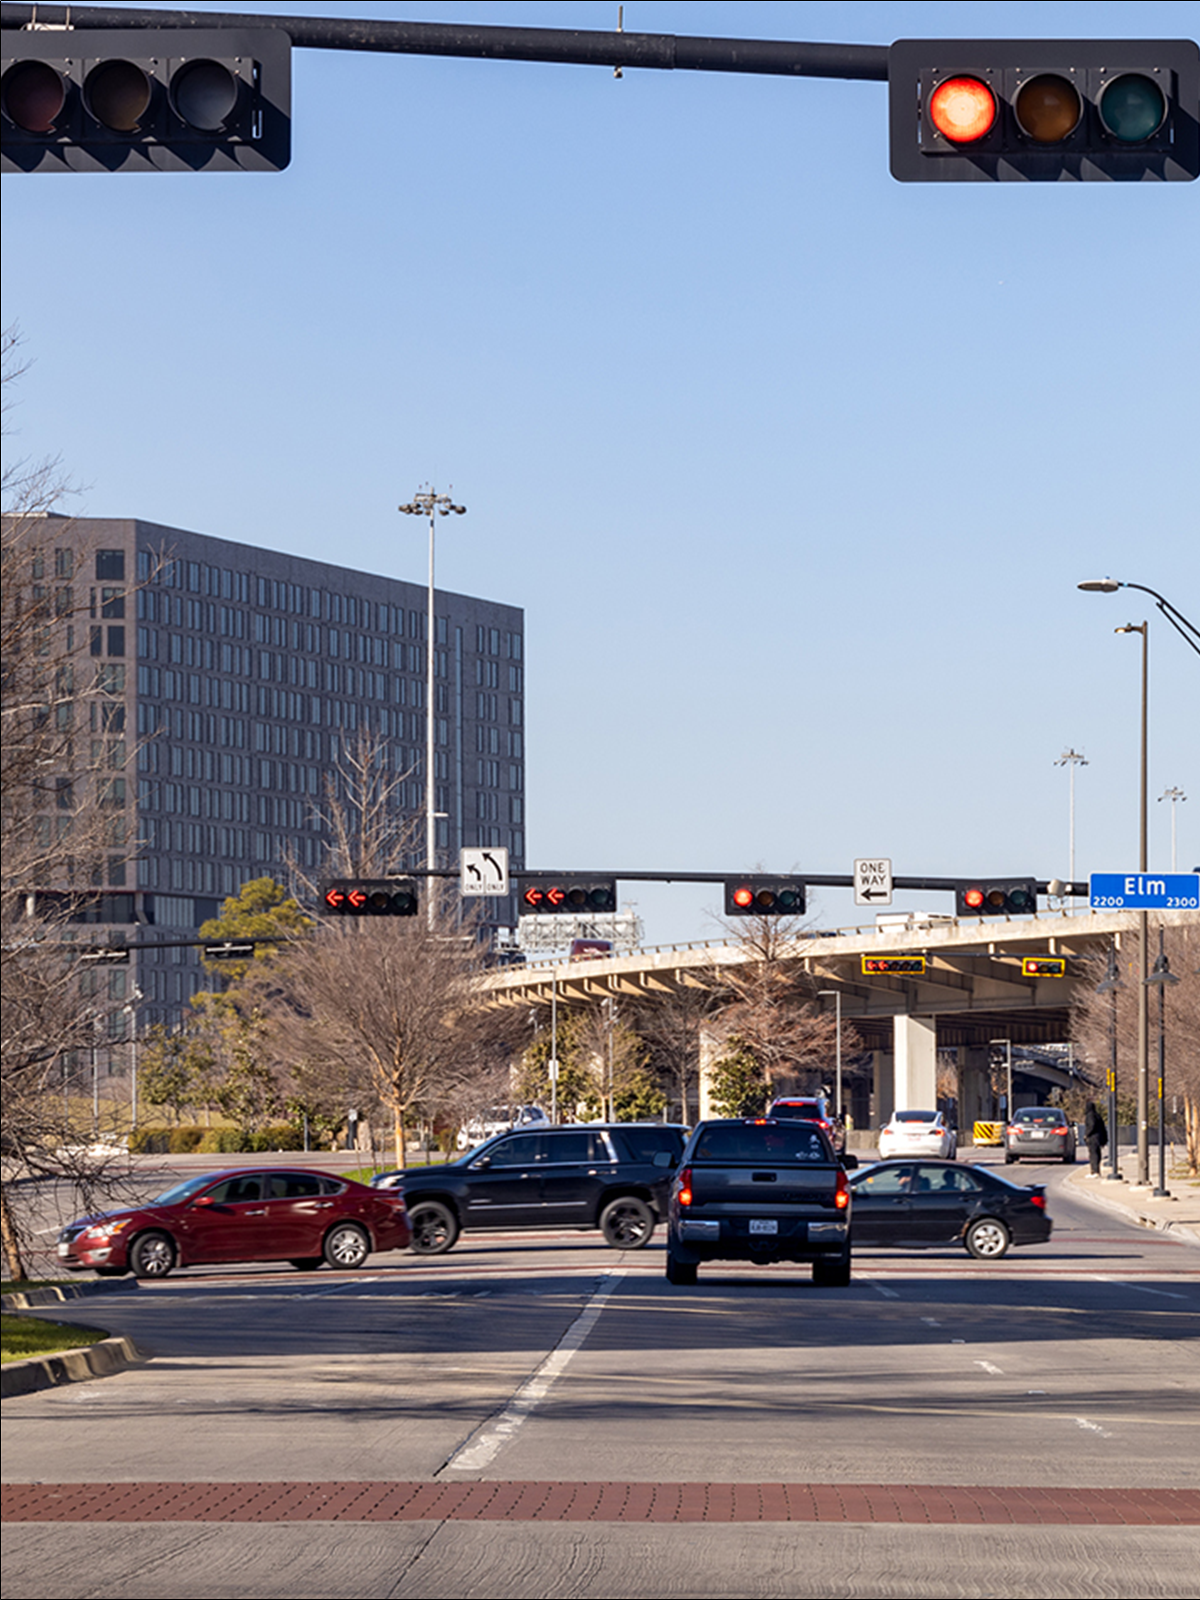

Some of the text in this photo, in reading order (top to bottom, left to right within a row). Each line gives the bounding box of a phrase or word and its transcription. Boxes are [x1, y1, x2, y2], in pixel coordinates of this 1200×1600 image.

[860, 862, 886, 874] ONE
[860, 875, 886, 886] WAY
[1124, 876, 1166, 895] Elm
[465, 883, 505, 891] ONLY ONLY
[1093, 896, 1197, 907] 2200 2300
